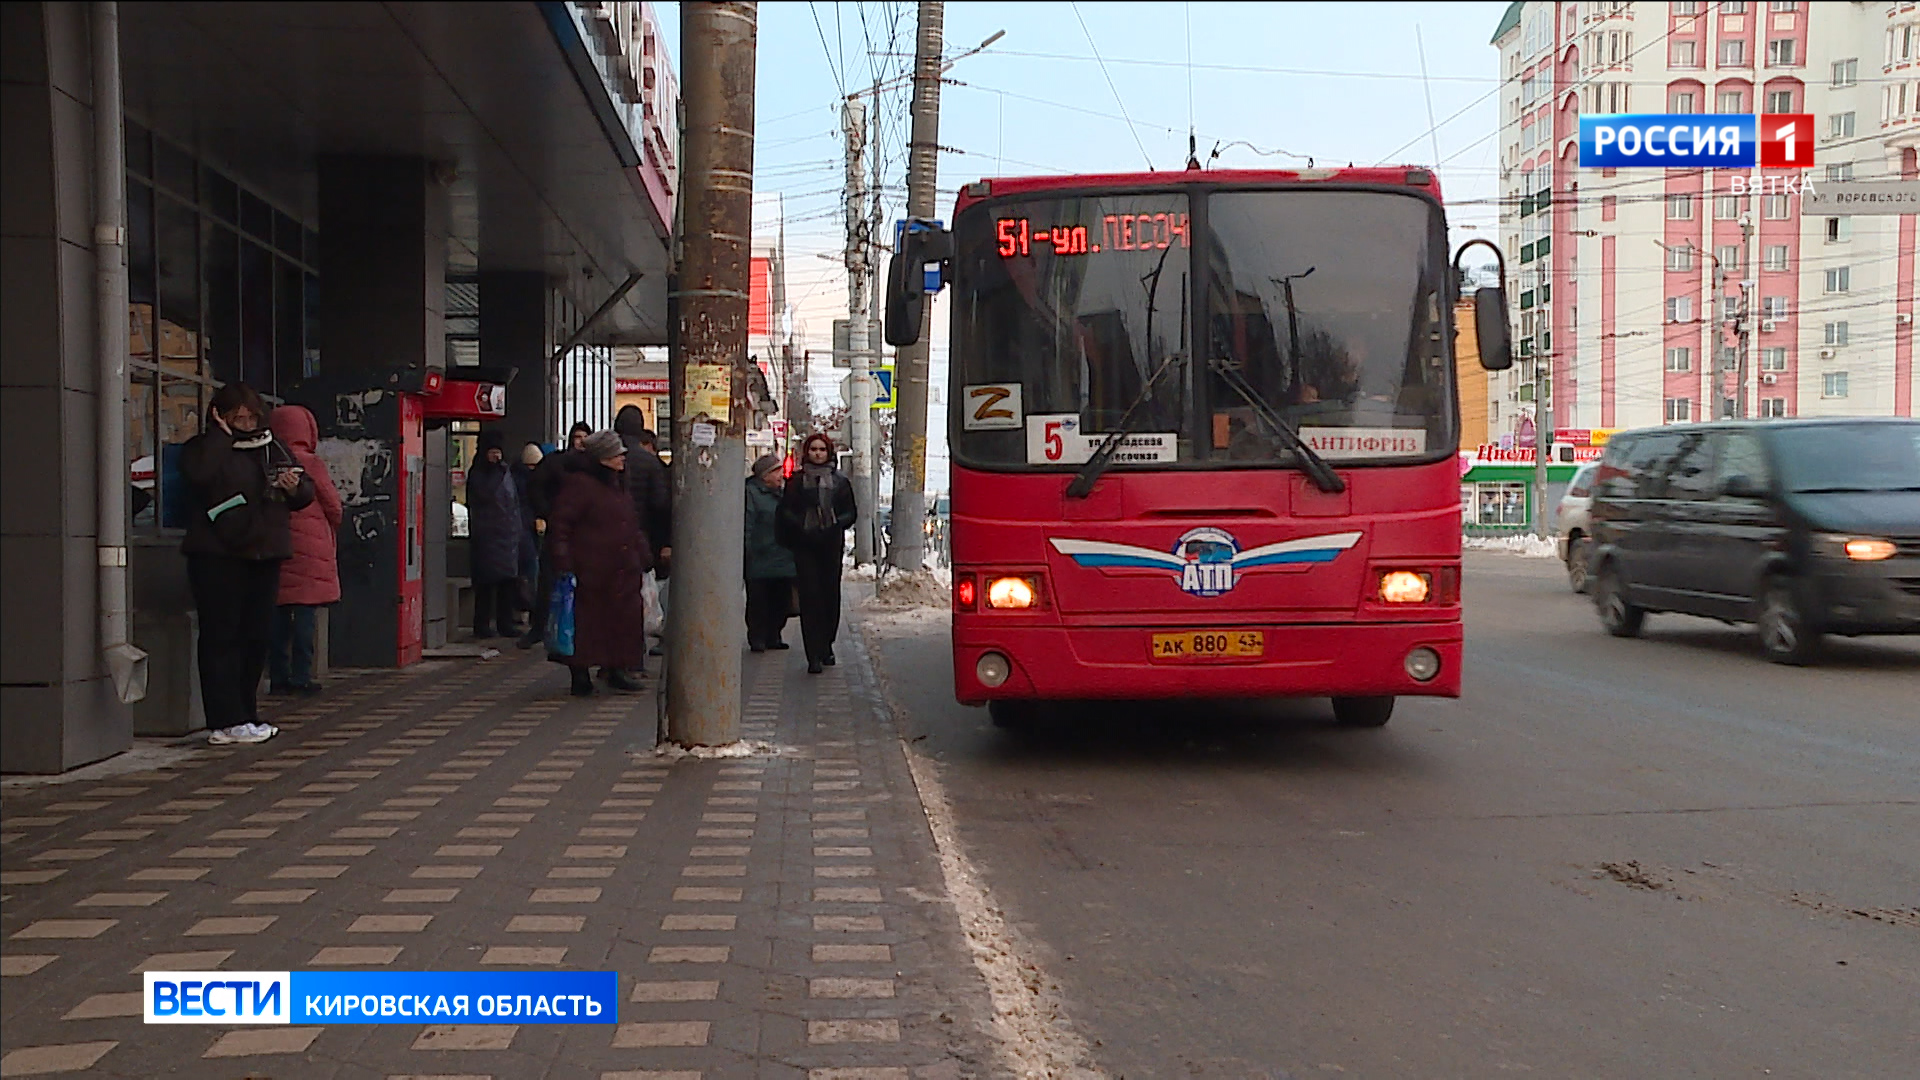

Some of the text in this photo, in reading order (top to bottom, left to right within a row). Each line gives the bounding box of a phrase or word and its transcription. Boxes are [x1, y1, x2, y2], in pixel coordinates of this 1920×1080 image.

[970, 388, 1014, 420] Z
[1044, 422, 1063, 460] 5
[1307, 436, 1417, 452] АНТИФРИЗ
[1182, 564, 1232, 590] АТП
[1193, 634, 1228, 652] 880
